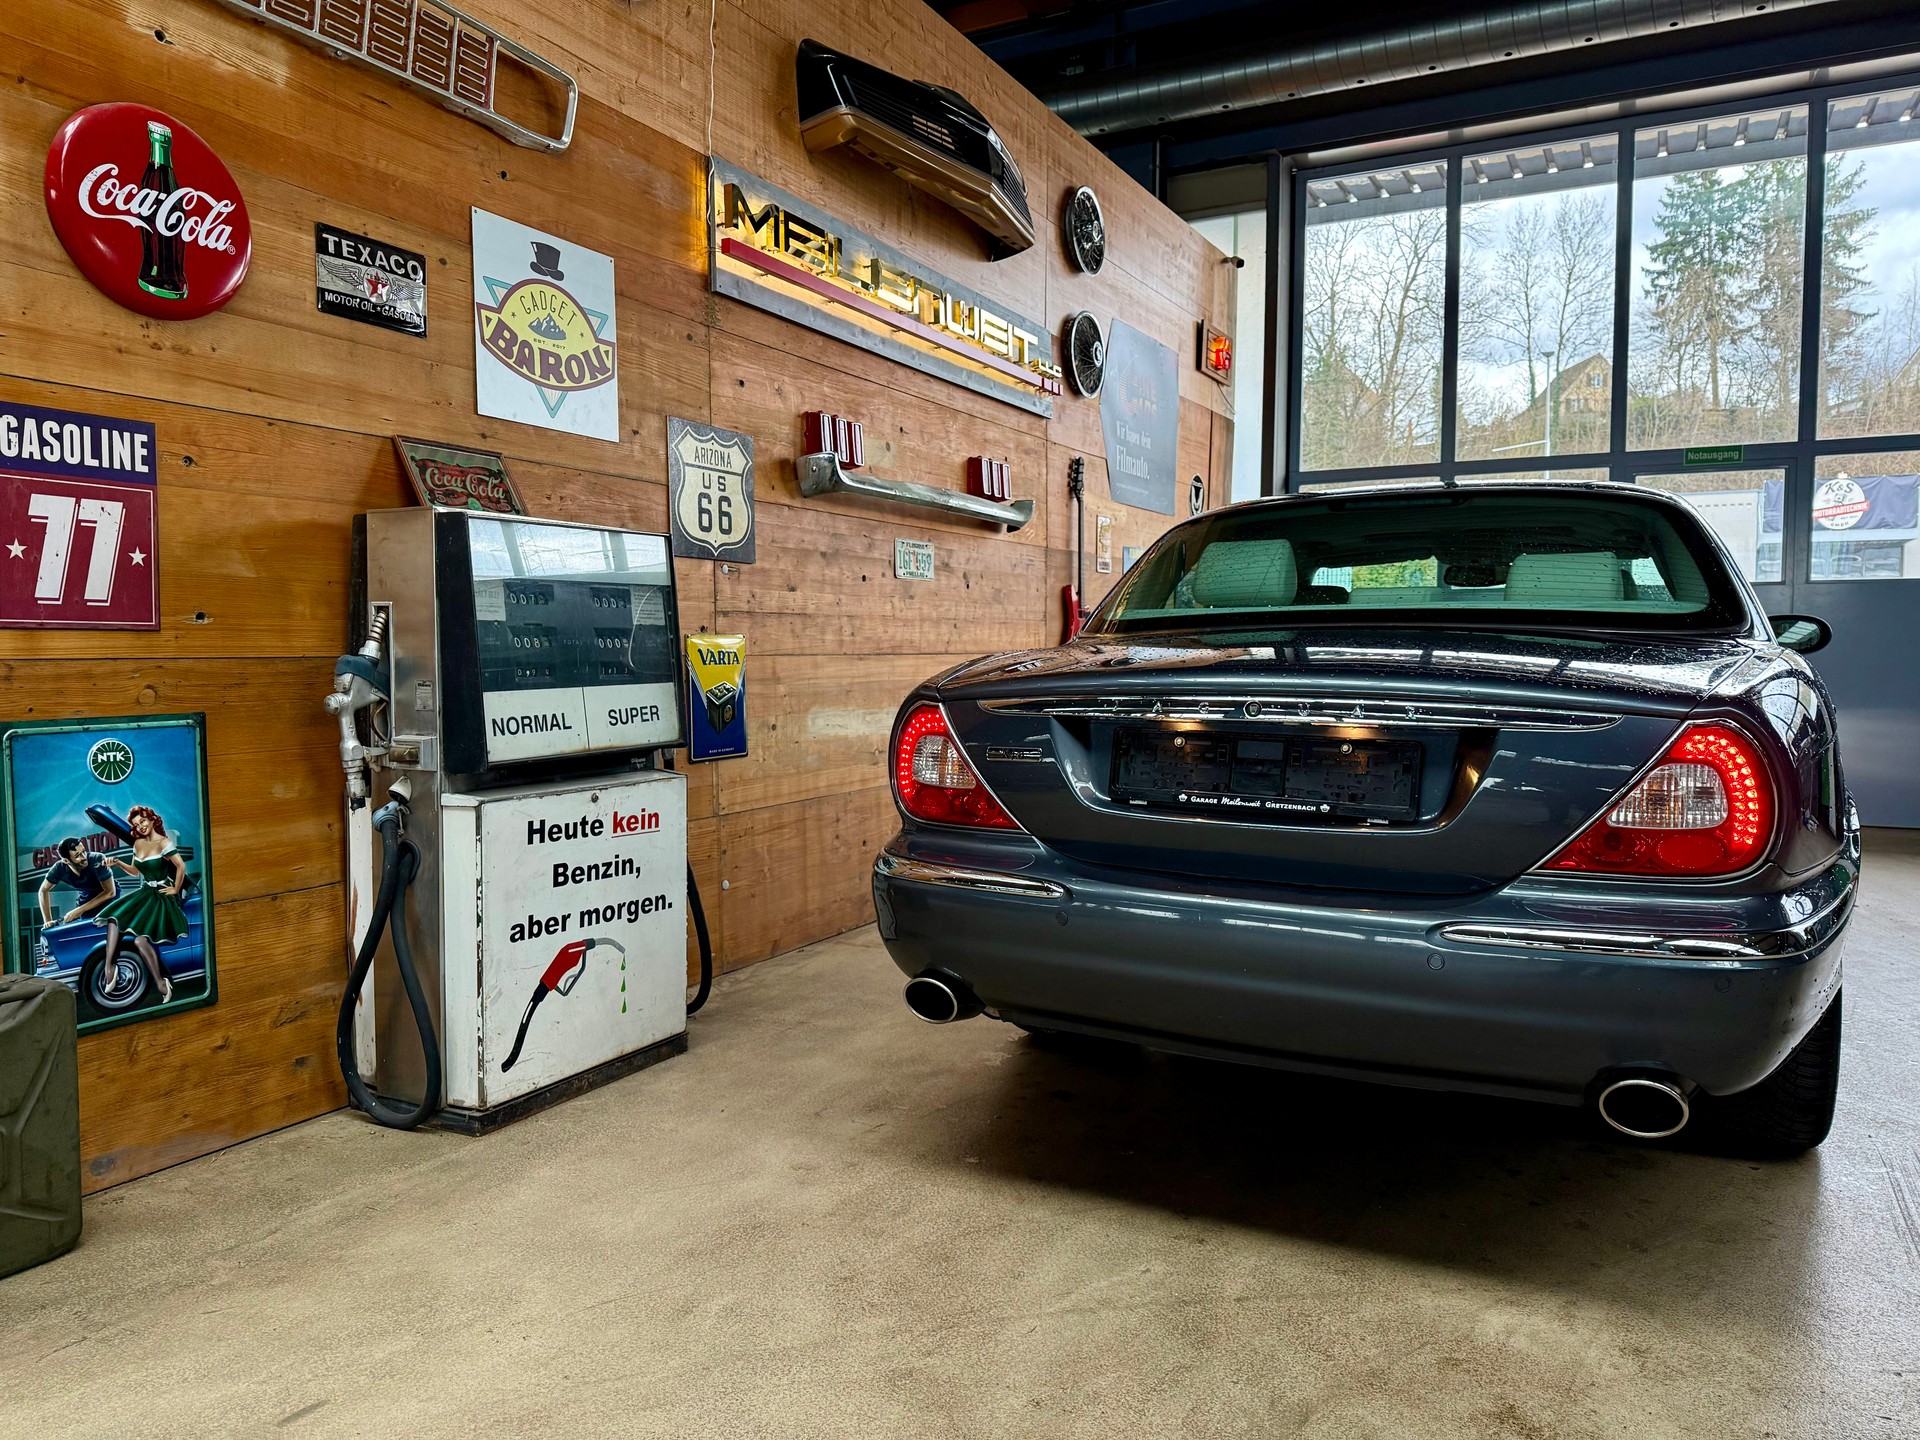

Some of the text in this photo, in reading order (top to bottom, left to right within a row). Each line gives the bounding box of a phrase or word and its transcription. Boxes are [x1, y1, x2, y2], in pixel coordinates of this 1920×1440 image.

[78, 163, 236, 252] Coca-Cola
[322, 233, 424, 282] TEXACO
[325, 291, 424, 326] MOTOR OIL GASOLINE
[520, 290, 577, 326] GADGET
[486, 321, 611, 384] BARON
[0, 414, 149, 473] GASOLINE
[694, 445, 732, 468] ARIZONA
[1687, 450, 1739, 462] Notausgang
[1116, 445, 1150, 480] Filmauto.
[425, 467, 505, 499] Coca-Cola
[702, 472, 726, 492] US
[698, 492, 732, 535] 66
[28, 493, 126, 606] 77
[698, 648, 740, 665] VARTA
[492, 704, 660, 737] NORMAL SUPER
[98, 750, 125, 763] NTK
[1190, 796, 1218, 804] GARAGE
[1265, 801, 1316, 812] GRETZENBACH
[527, 808, 660, 845] Heute kein
[33, 844, 61, 869] GAS
[553, 854, 641, 888] Benzin,
[509, 893, 673, 943] aber morgen.
